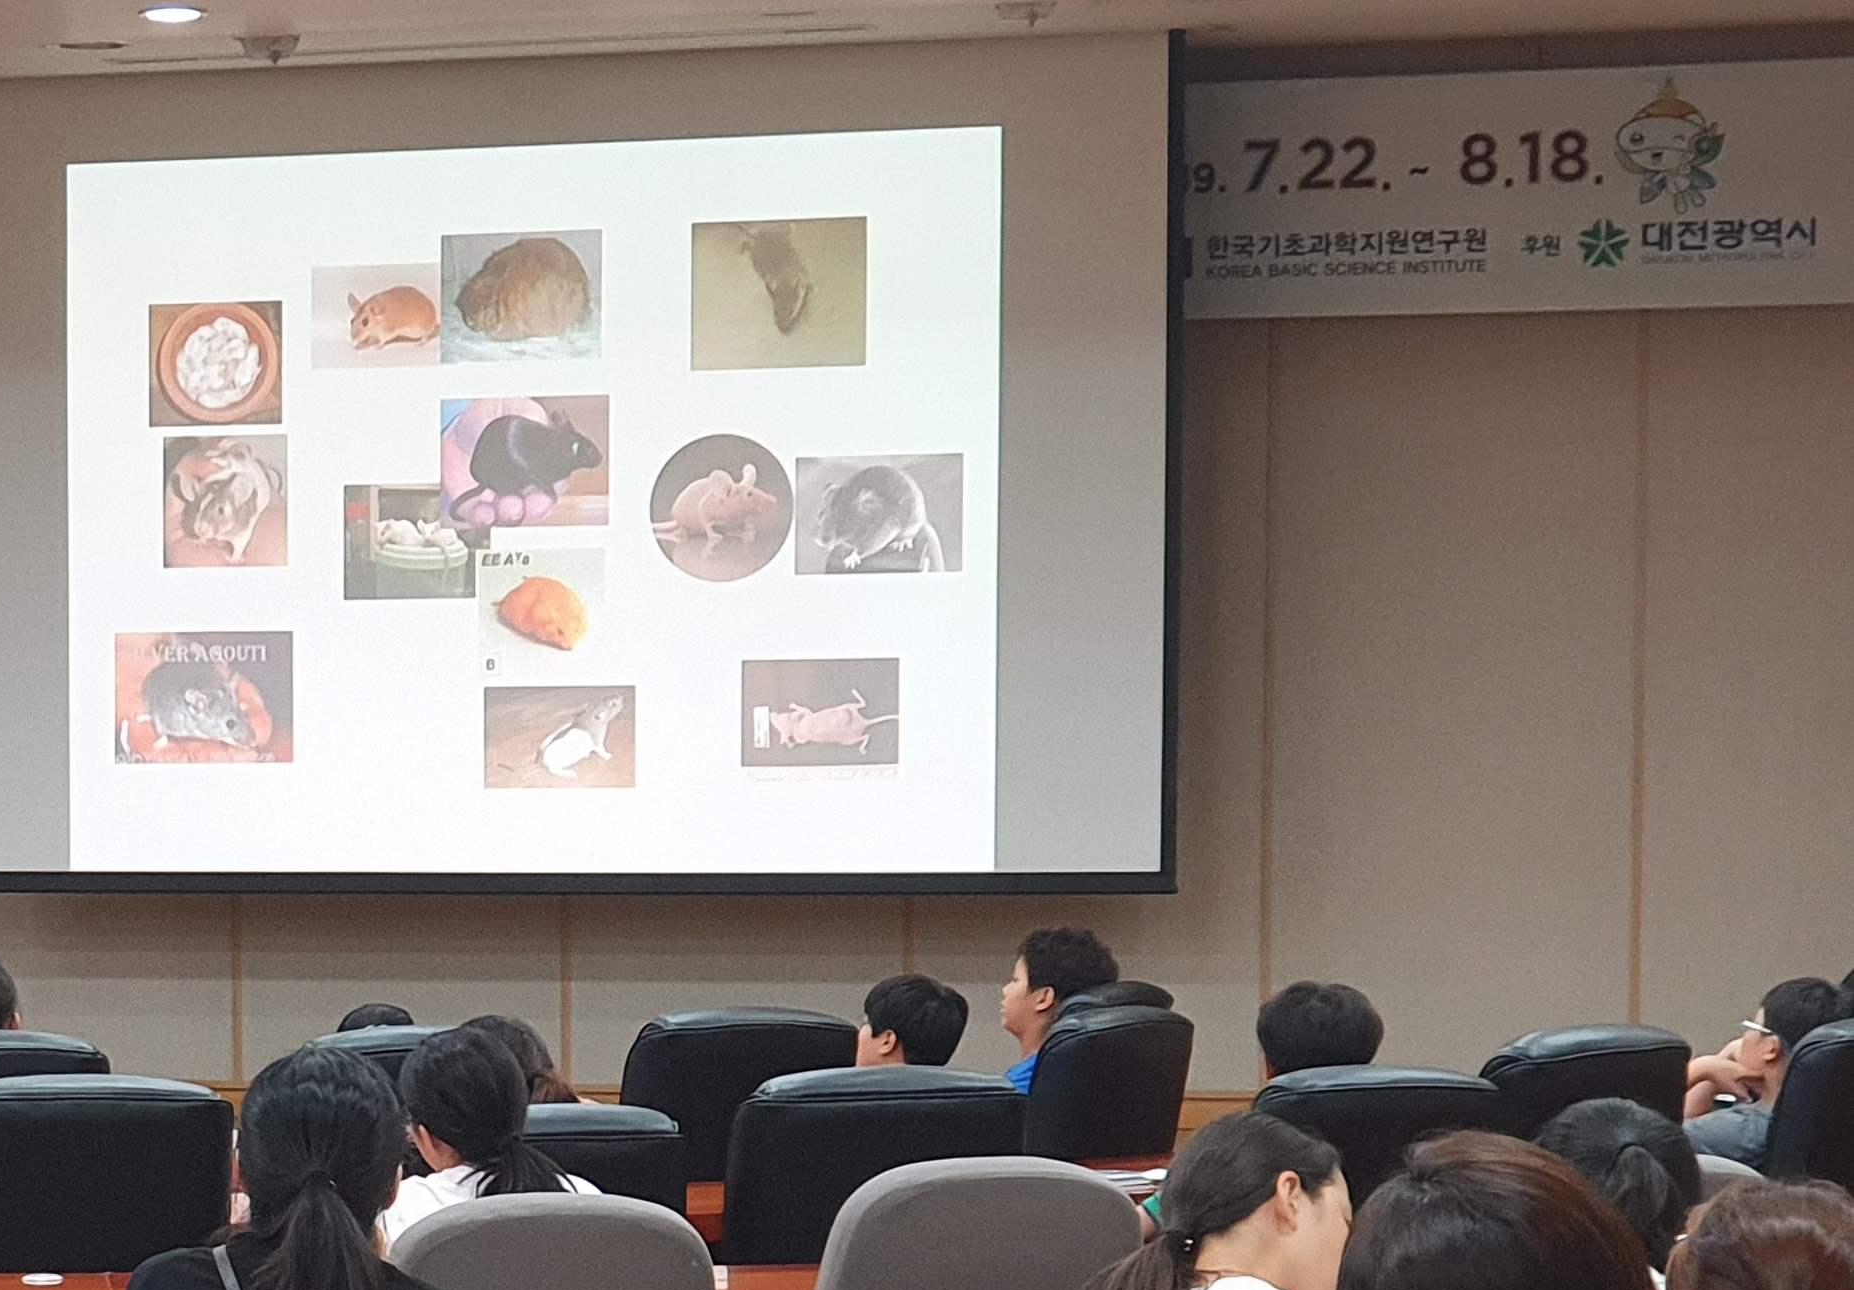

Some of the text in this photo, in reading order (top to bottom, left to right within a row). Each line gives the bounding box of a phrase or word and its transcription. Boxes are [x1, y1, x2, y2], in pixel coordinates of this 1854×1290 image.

[1186, 161, 1226, 194] 9.
[1459, 130, 1605, 187] 8.18.
[1207, 227, 1488, 260] 한국기초과학지원연구원
[1521, 234, 1562, 257] 후원
[1641, 217, 1818, 253] 대전광역시
[1206, 258, 1487, 279] KOREA BASIC SCIENCE INSTITUTE
[192, 643, 267, 661] AGOUTI
[486, 658, 496, 671] B
